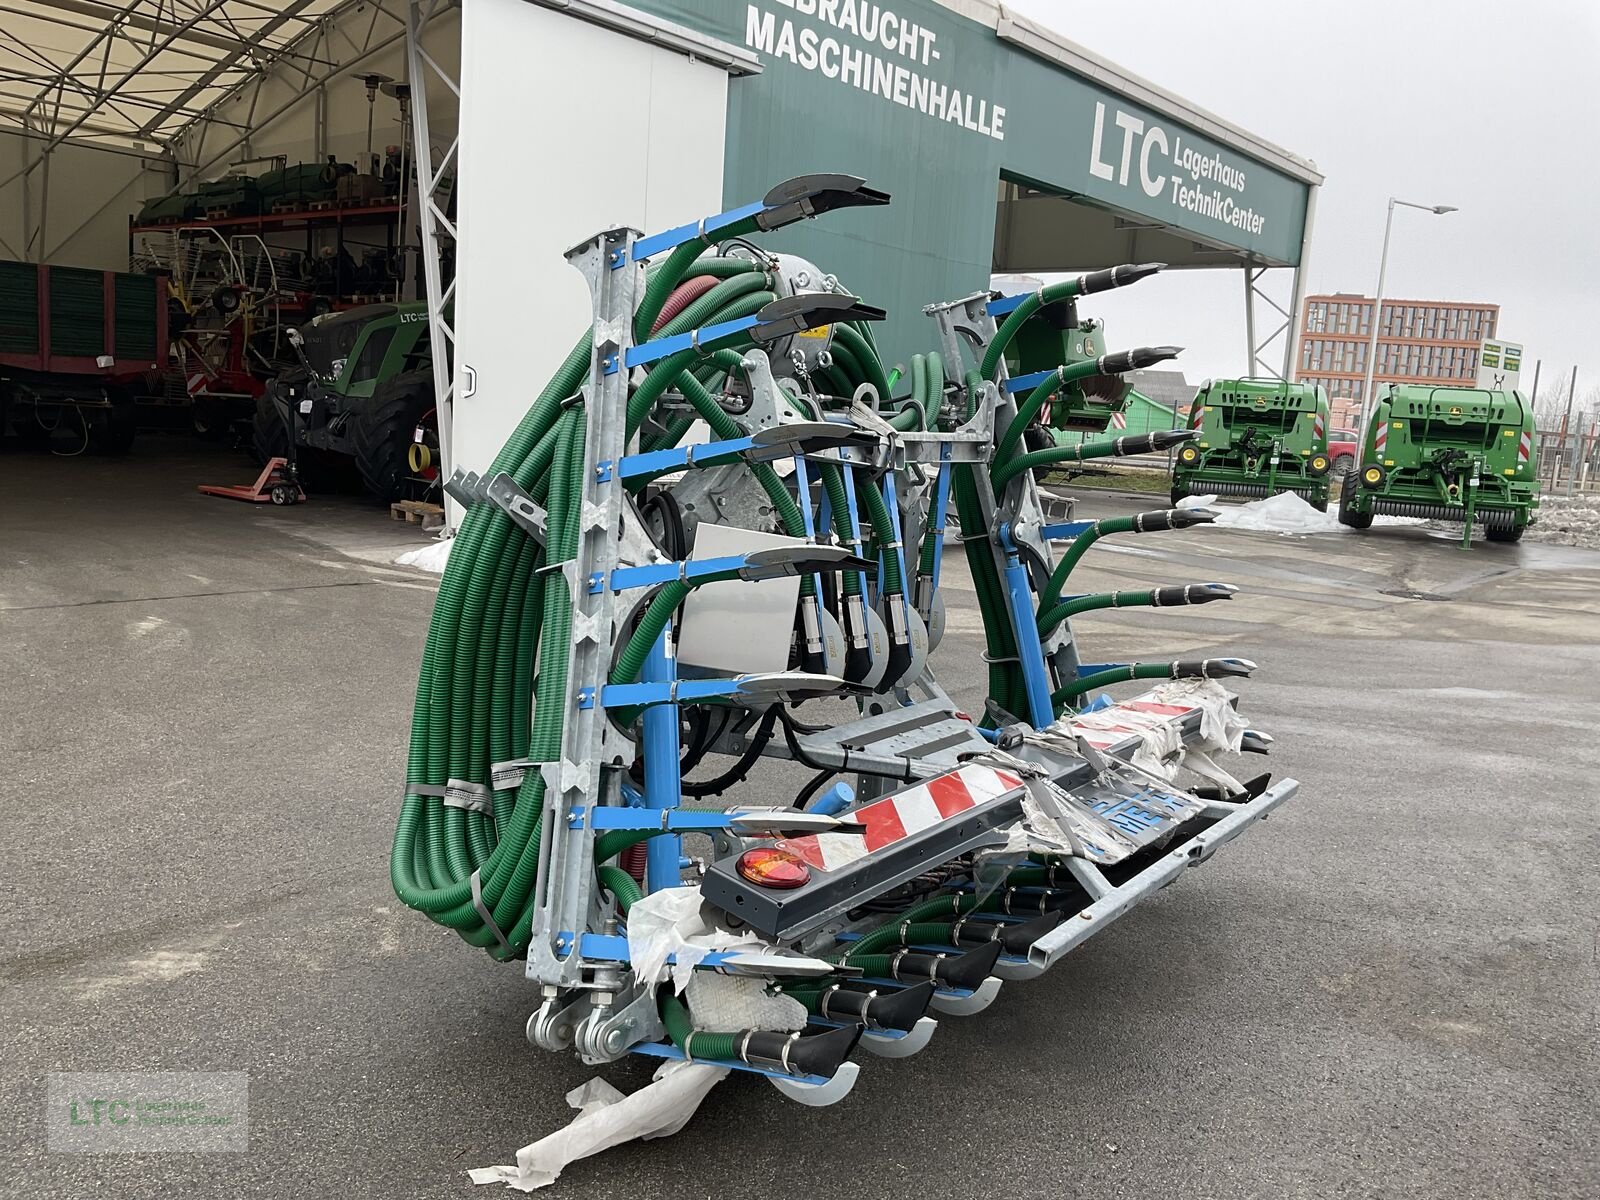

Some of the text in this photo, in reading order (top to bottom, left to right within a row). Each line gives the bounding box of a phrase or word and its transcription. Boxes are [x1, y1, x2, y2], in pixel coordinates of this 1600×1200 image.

[776, 0, 940, 66] RAUCHT-
[745, 5, 1006, 141] MASCHINENHALLE
[1089, 101, 1169, 197] LTC
[1173, 137, 1246, 192] Lagerhaus
[1171, 175, 1265, 235] TechnikCenter
[400, 313, 418, 323] LTC
